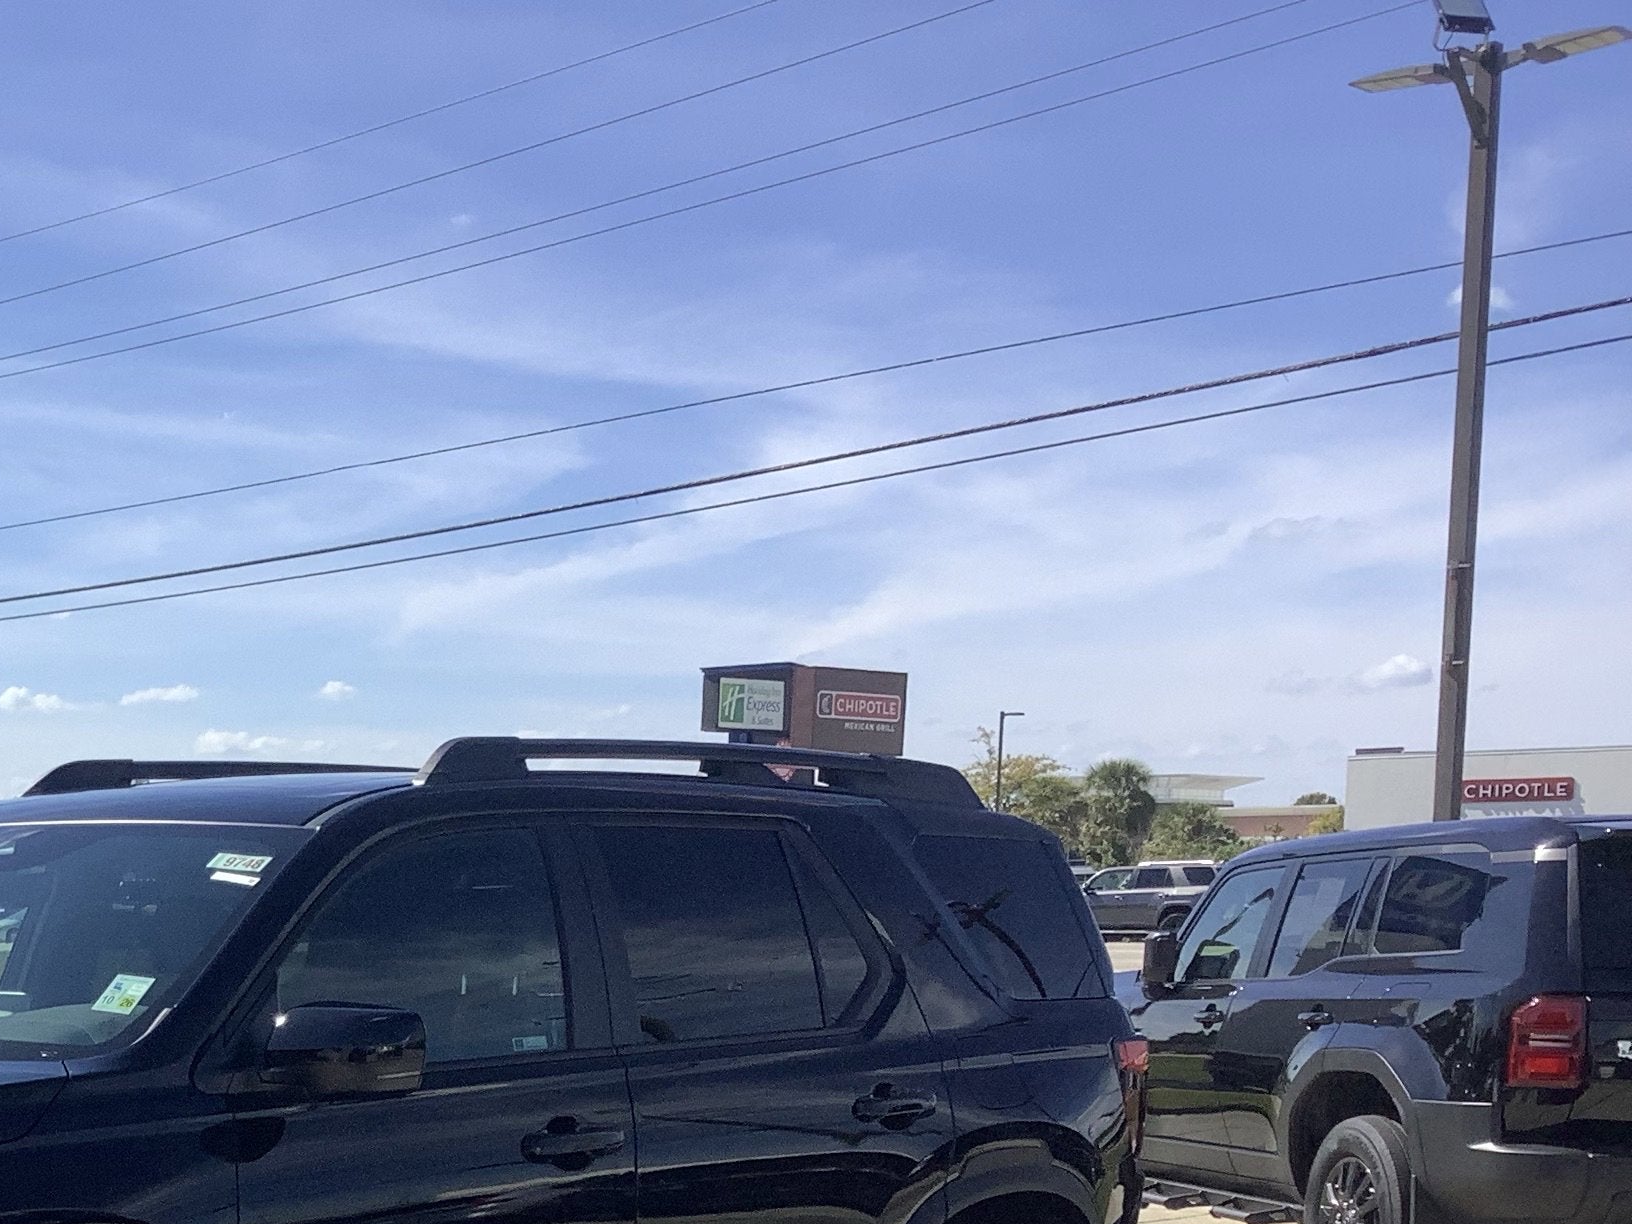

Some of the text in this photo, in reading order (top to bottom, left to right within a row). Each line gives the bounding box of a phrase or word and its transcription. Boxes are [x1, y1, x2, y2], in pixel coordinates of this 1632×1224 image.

[746, 695, 780, 715] Express
[836, 698, 897, 715] CHIPOTLE
[844, 722, 896, 733] MEXICAN GRILL
[1463, 781, 1569, 799] CHIPOTLE
[101, 995, 115, 1004] 10
